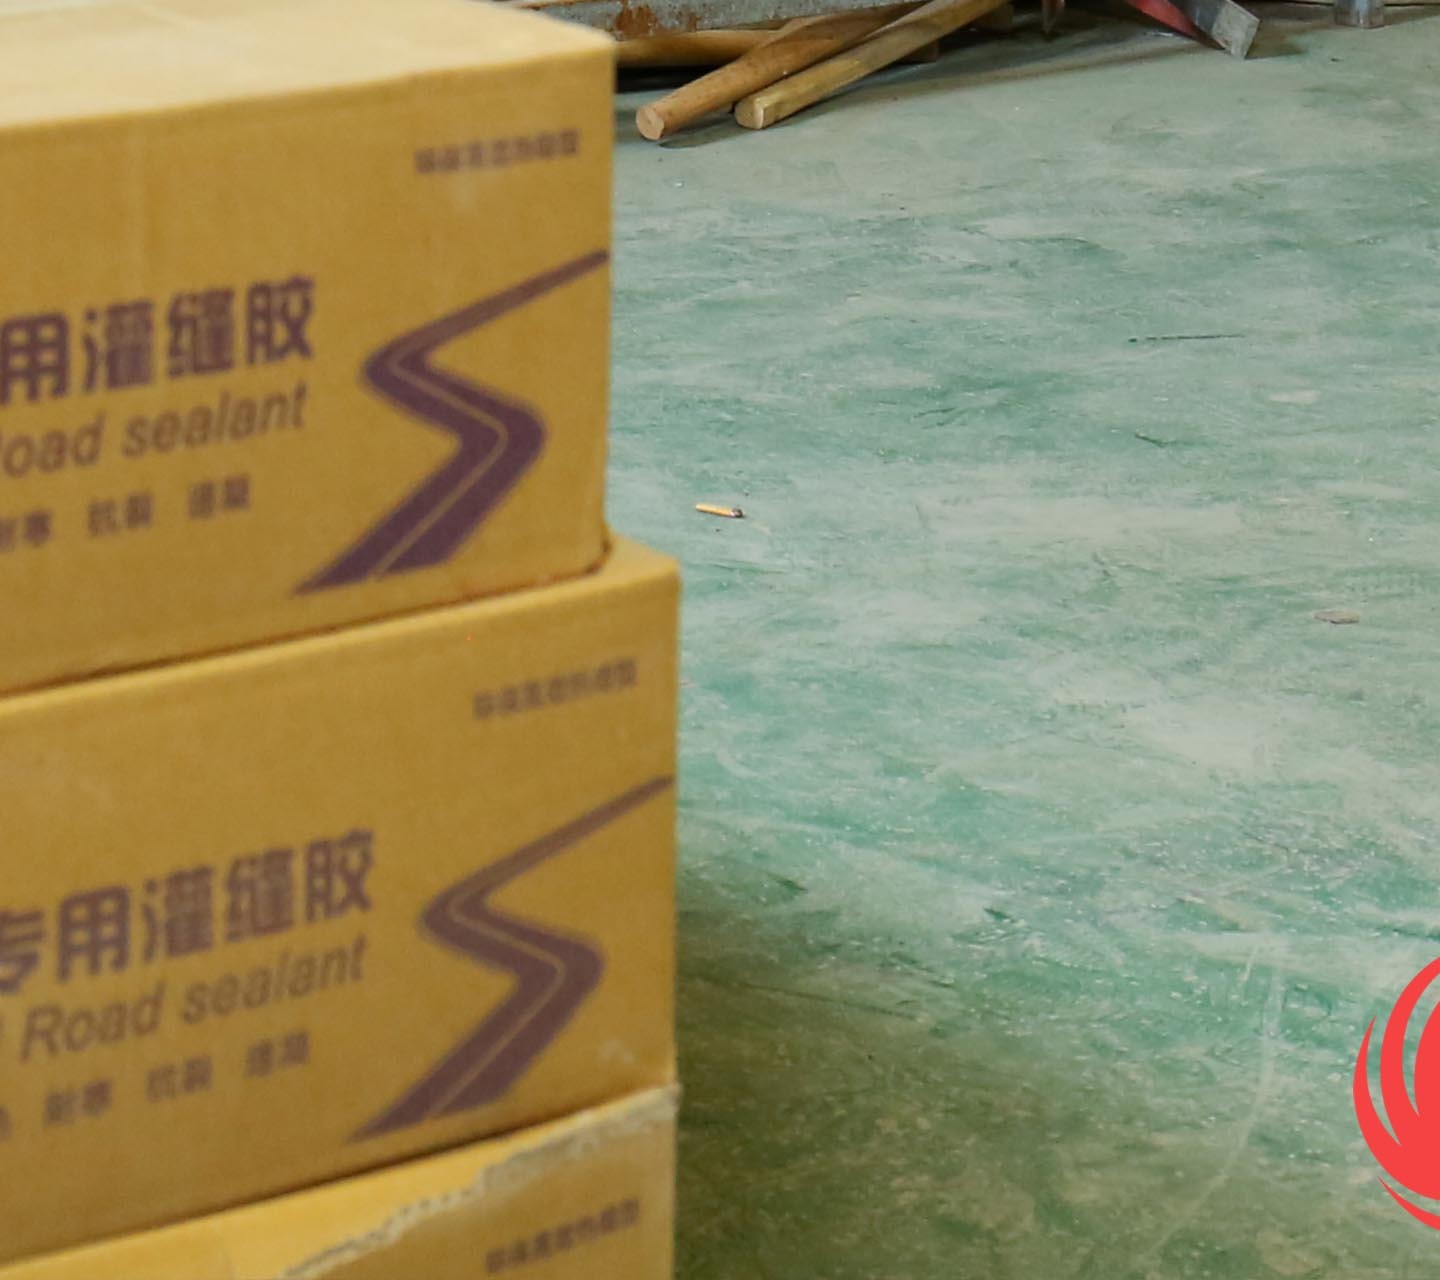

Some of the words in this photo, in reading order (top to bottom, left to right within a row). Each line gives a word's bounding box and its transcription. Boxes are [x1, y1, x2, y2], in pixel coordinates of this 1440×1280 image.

[122, 382, 309, 460] sealant
[22, 979, 165, 1064] Road
[183, 933, 369, 1016] sealant
